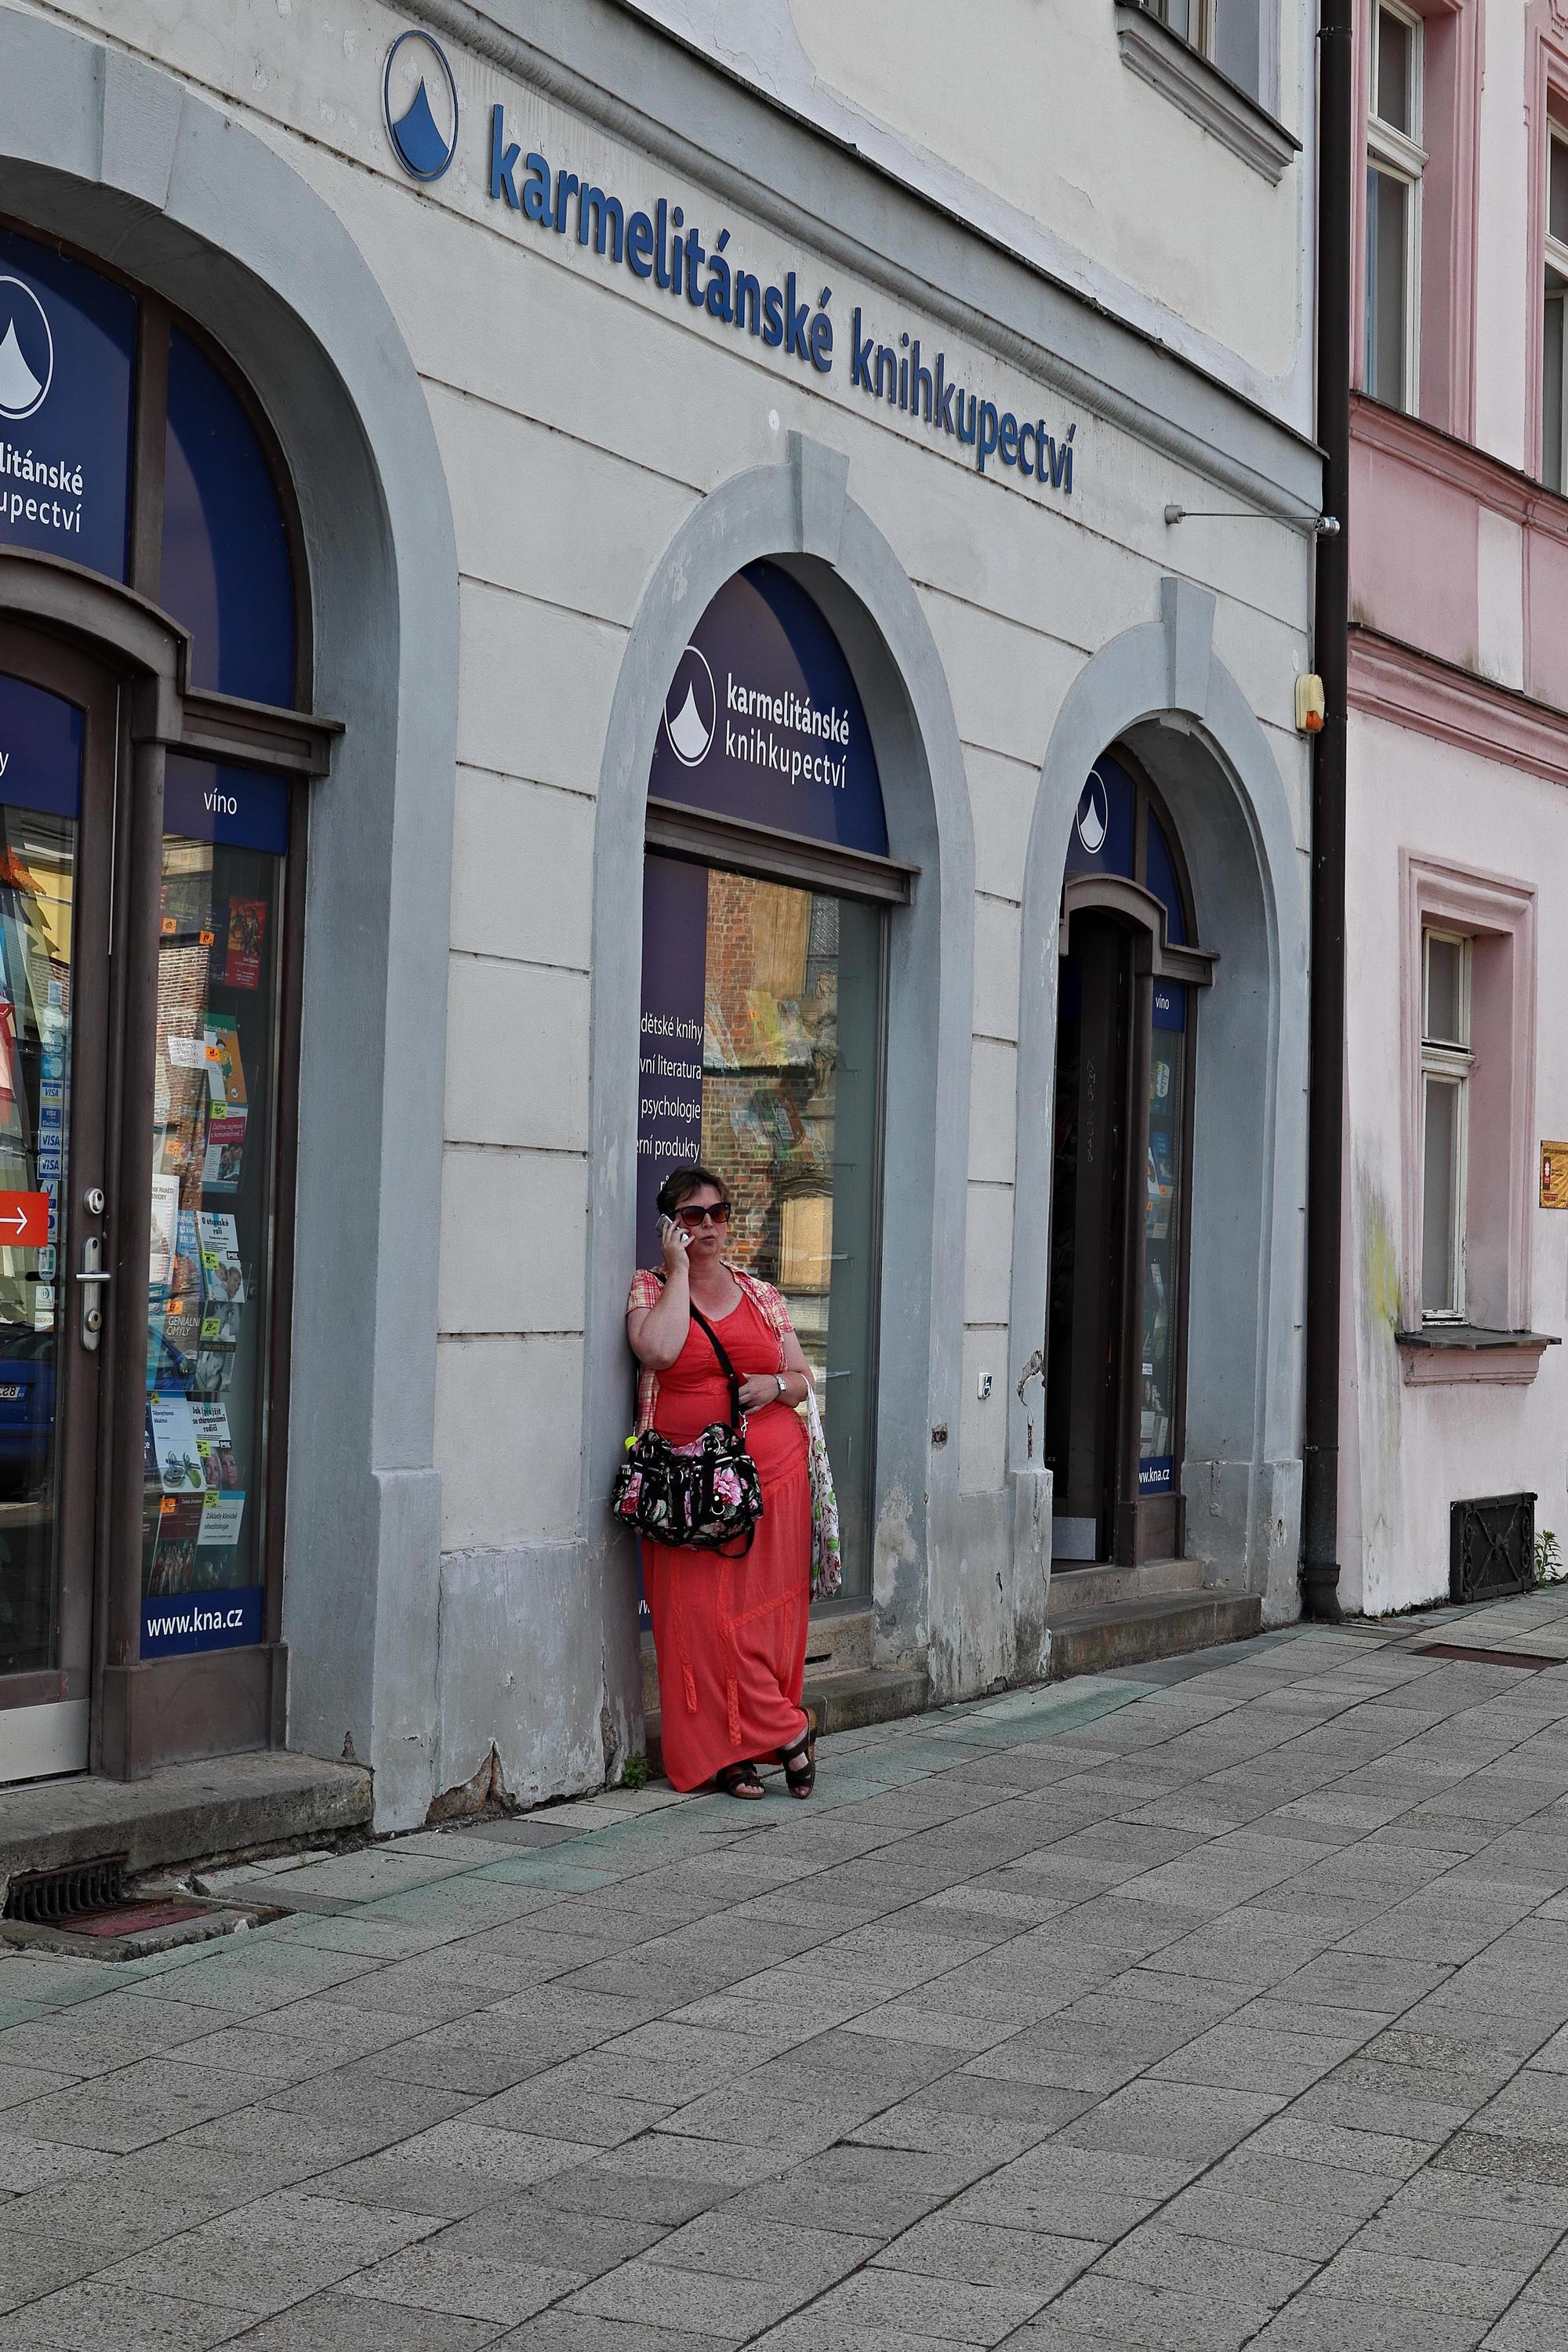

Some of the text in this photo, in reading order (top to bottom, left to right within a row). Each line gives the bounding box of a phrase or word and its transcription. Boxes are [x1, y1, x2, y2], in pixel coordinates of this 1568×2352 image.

[491, 103, 1076, 494] karmelitánské knihkupectví
[0, 441, 83, 495] litánské
[727, 673, 849, 746] karmelitánské
[725, 720, 847, 789] knihkupectví
[204, 788, 238, 815] víno
[1156, 994, 1170, 1010] víno
[641, 1011, 702, 1046] dětské knihy
[640, 1054, 702, 1080] vní literatura
[45, 1088, 59, 1097] VISA
[641, 1094, 701, 1123] psychologie
[42, 1134, 60, 1145] VISA
[637, 1134, 700, 1163] rní produkty
[42, 1160, 60, 1171] VISA
[147, 1606, 243, 1637] www.kna.cz
